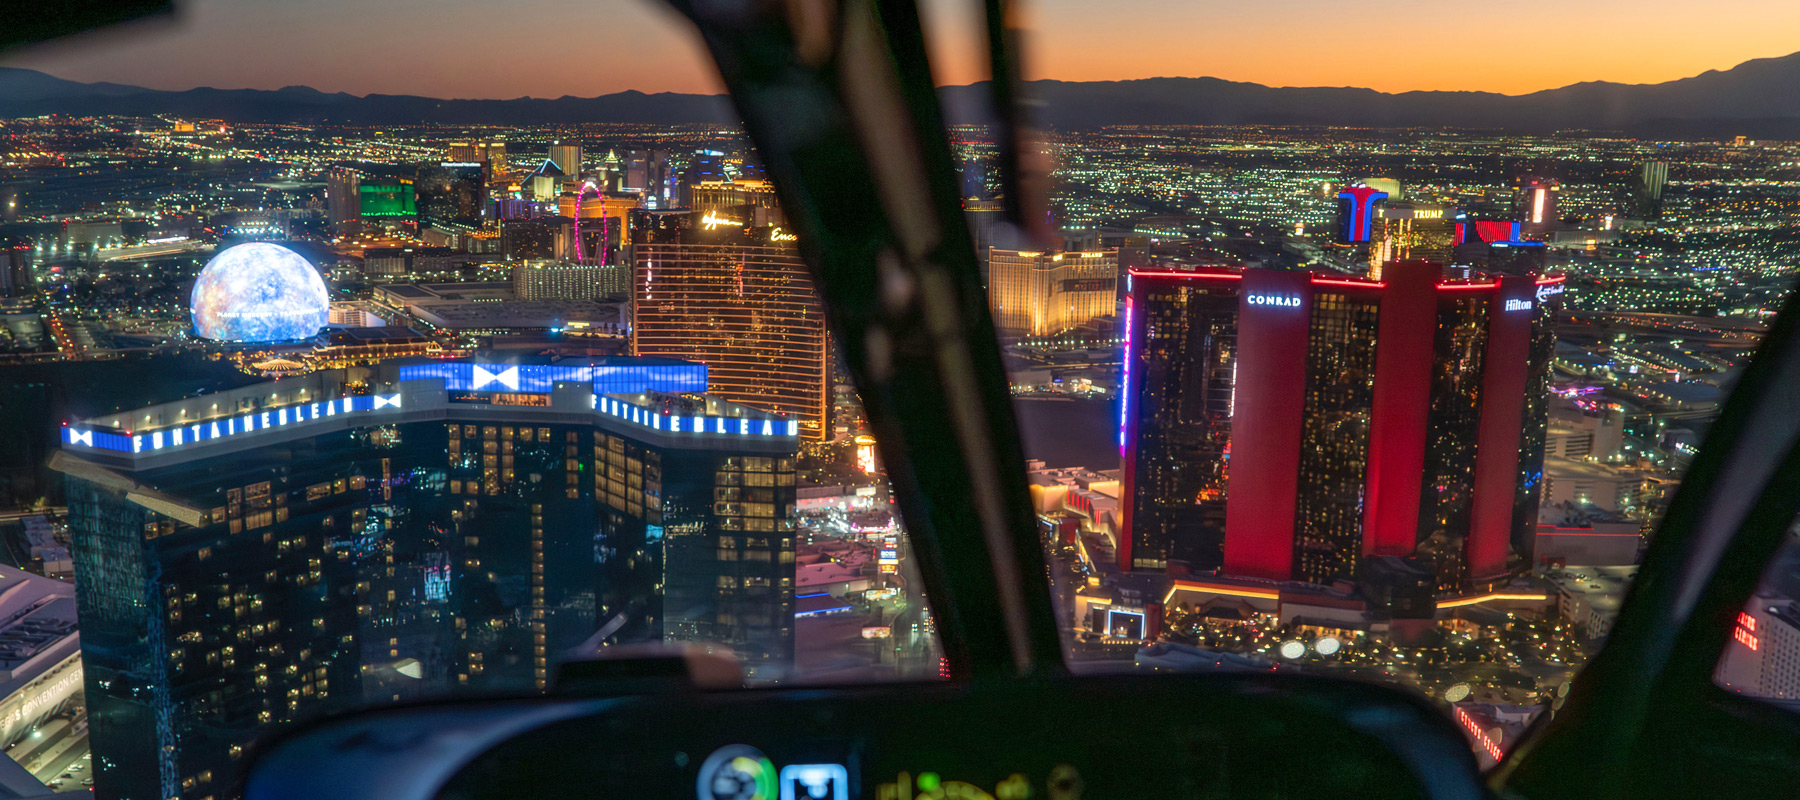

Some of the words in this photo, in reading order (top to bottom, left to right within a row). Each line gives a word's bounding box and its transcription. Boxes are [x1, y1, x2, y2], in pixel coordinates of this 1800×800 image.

[1413, 209, 1444, 219] TRUMP
[1247, 295, 1301, 307] CONRAD
[1505, 298, 1532, 311] Hilton
[133, 397, 353, 453] FONTAINEBLEAU
[590, 394, 798, 436] FONTAINEBLEAU
[22, 677, 69, 716] CONVENTION
